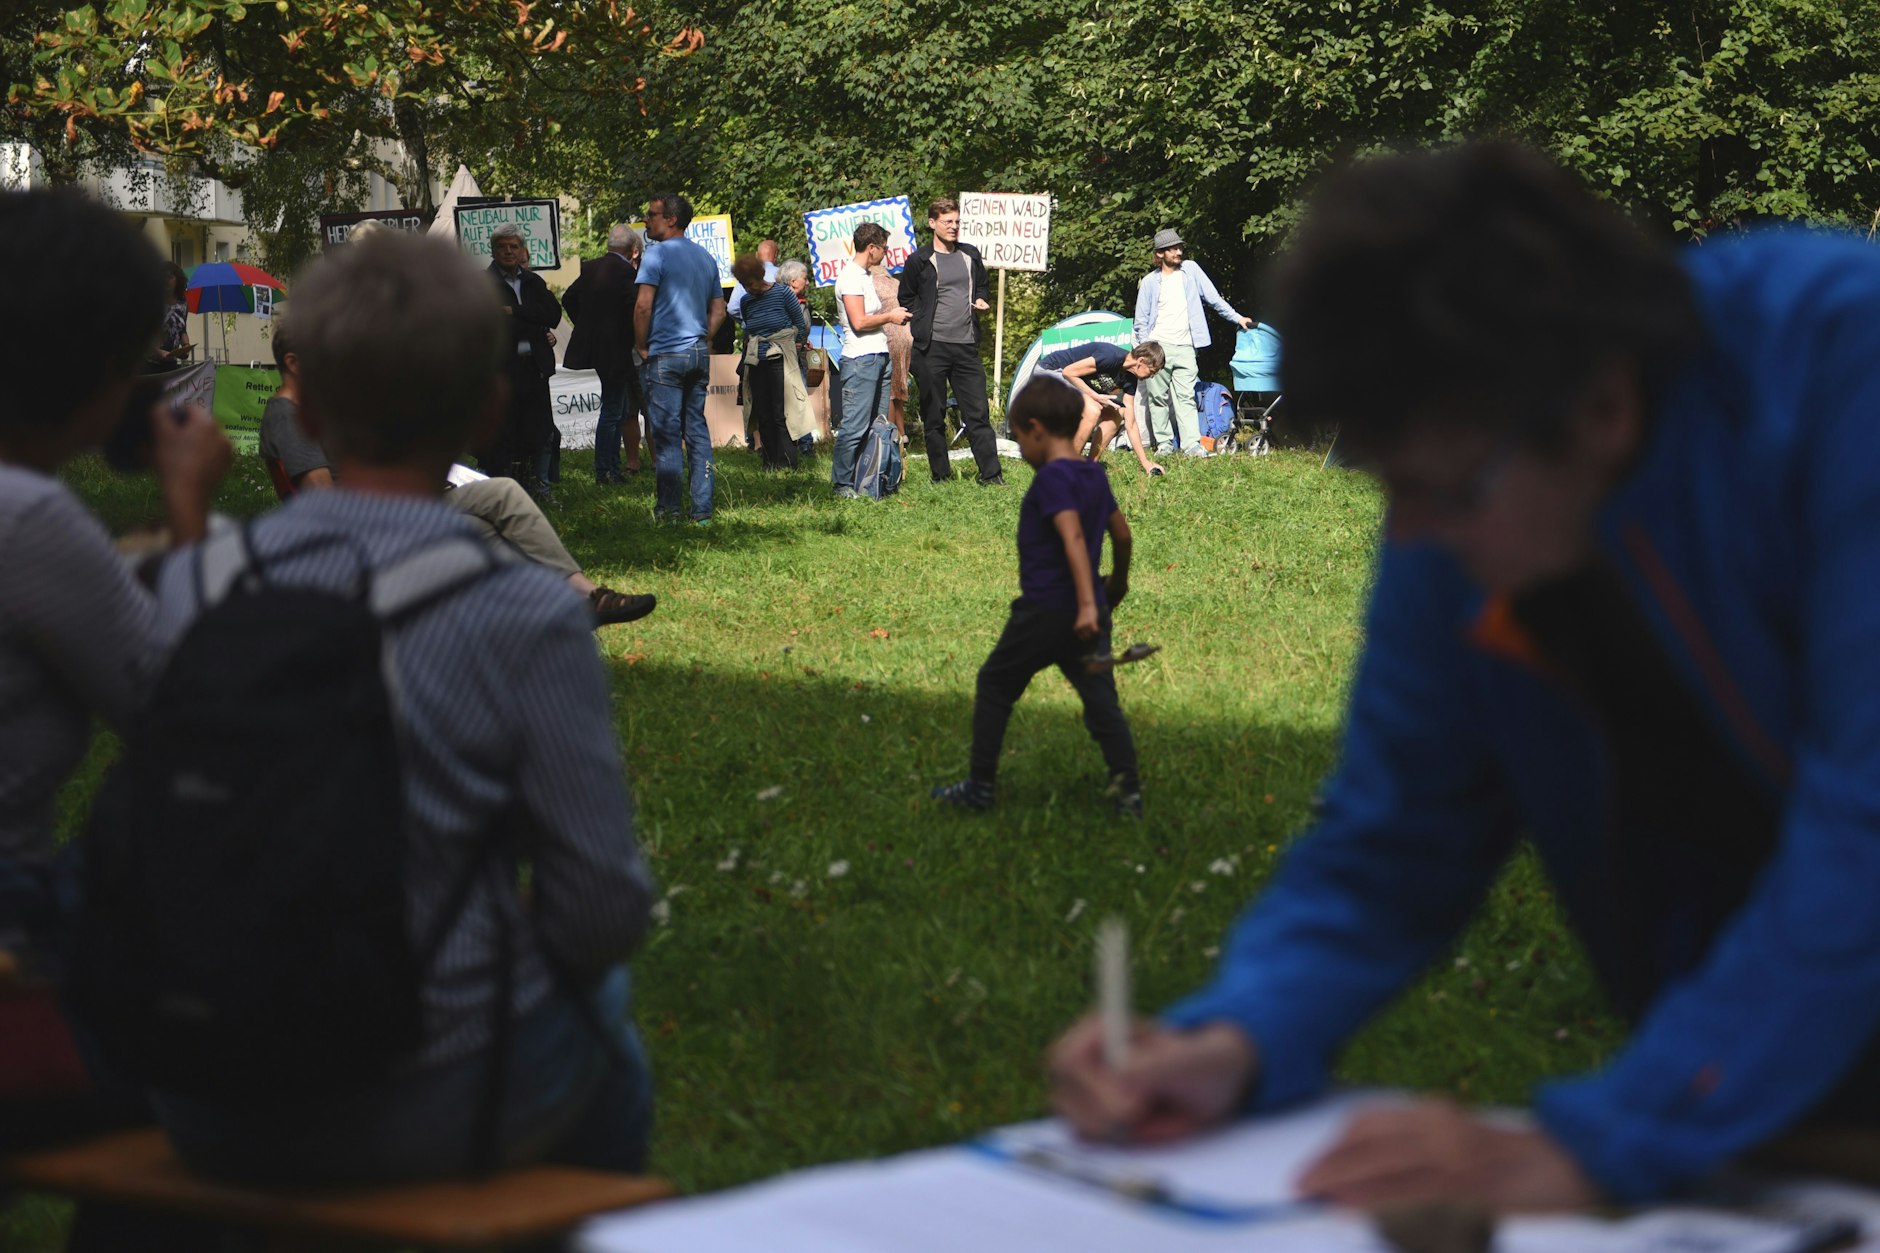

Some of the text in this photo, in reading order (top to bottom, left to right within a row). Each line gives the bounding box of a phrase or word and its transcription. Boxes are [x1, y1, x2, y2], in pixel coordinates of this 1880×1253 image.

[460, 206, 541, 225] NEUBAU NUR
[963, 198, 1047, 218] KEINEN WALD
[464, 226, 484, 240] AUF
[985, 221, 1007, 237] DEN
[1012, 221, 1046, 238] NEU-
[994, 243, 1042, 264] RODEN
[246, 382, 273, 392] Rettet
